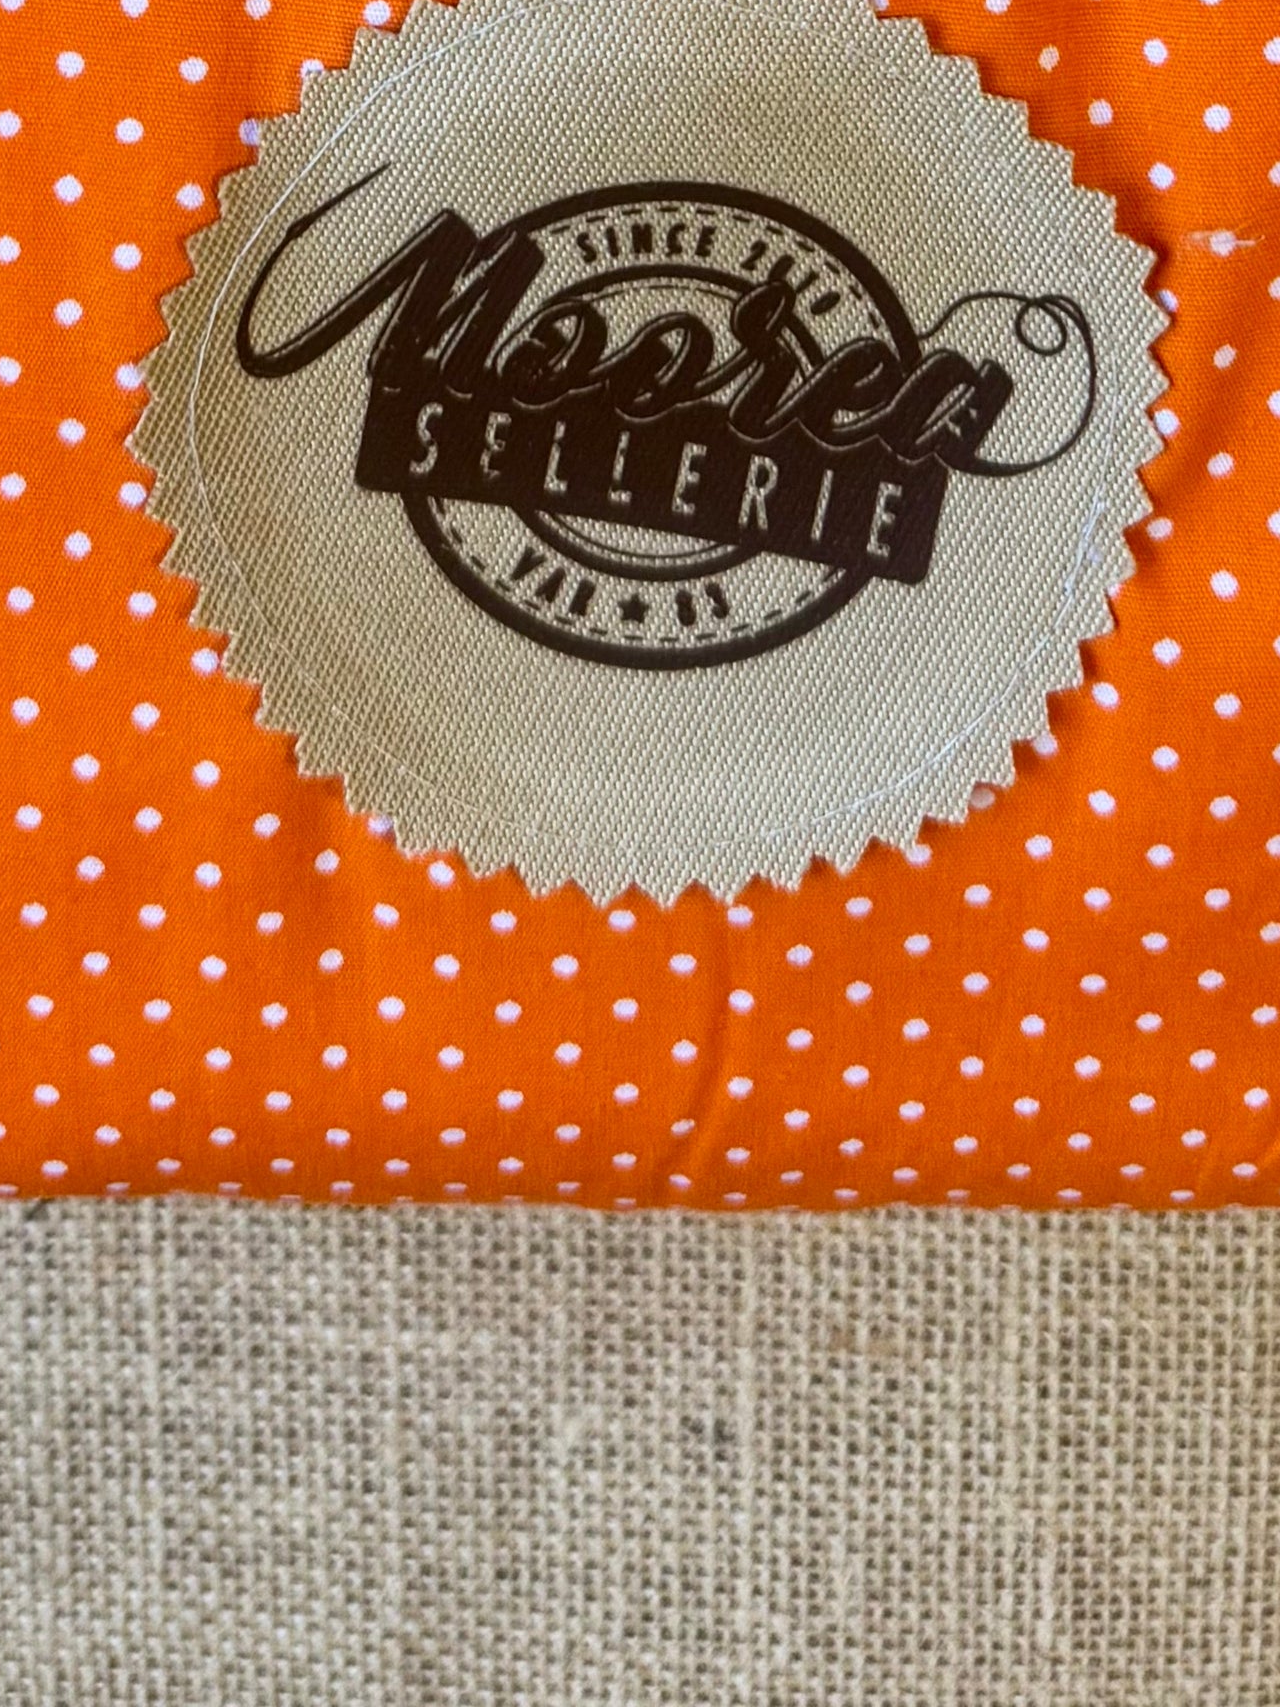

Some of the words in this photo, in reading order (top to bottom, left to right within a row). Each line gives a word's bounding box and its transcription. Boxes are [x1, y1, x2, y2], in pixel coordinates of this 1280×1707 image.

[577, 222, 718, 264] SINCE
[237, 169, 1092, 475] Moorea
[408, 402, 904, 559] SELLERIE
[511, 545, 596, 617] VAR
